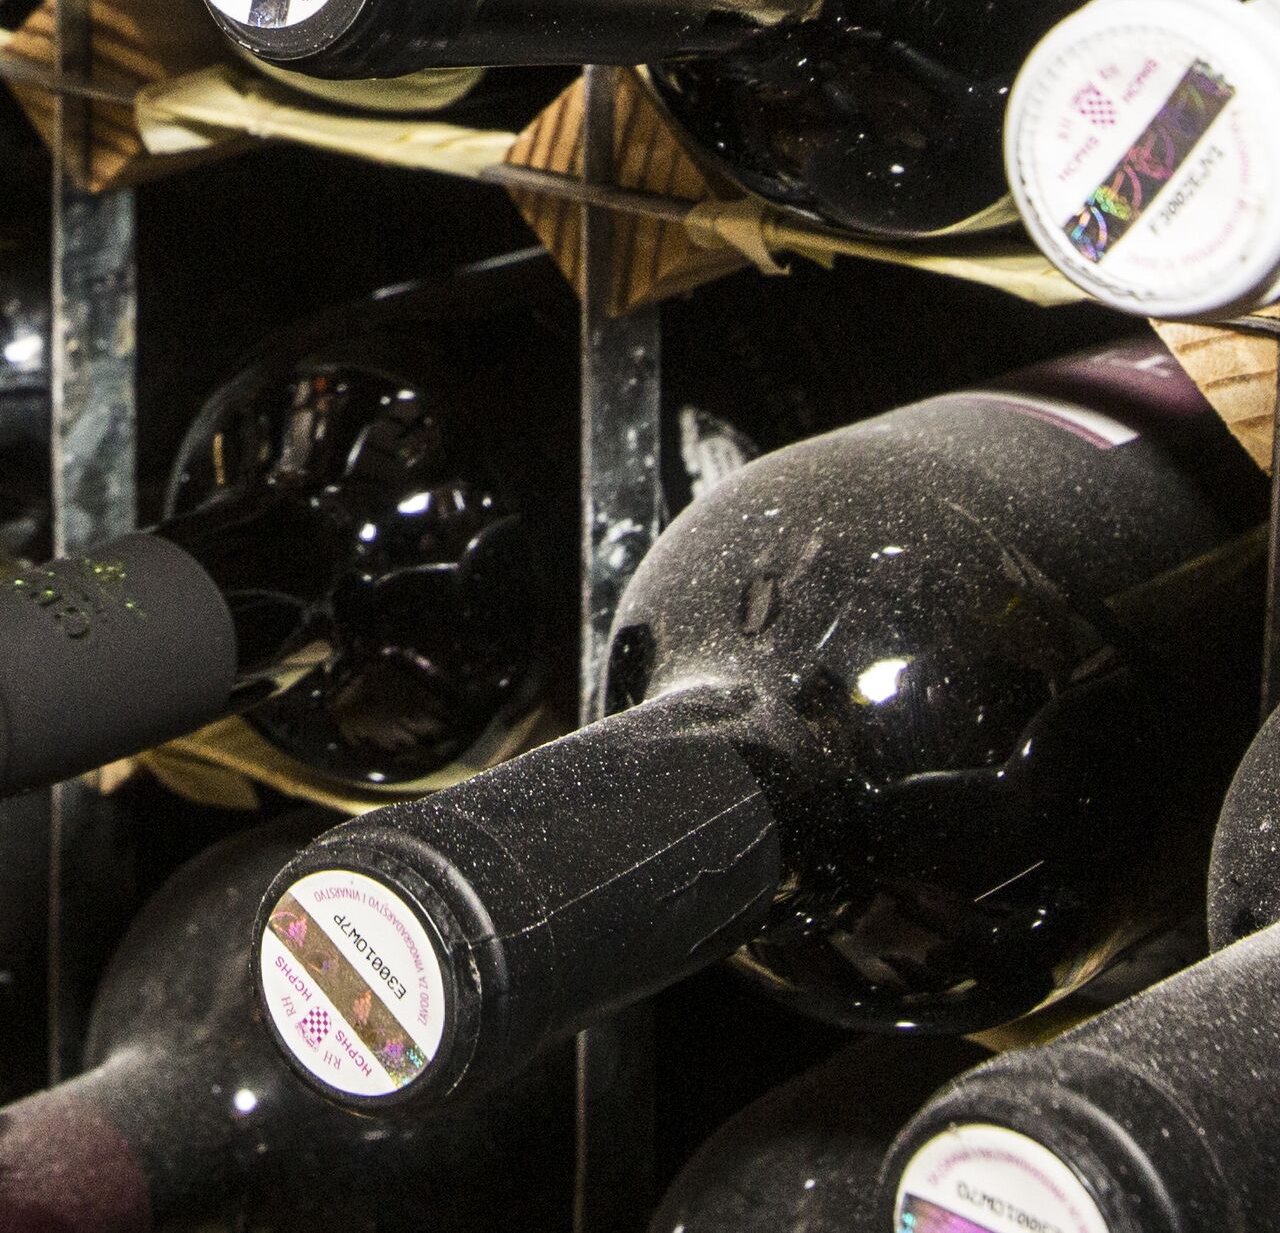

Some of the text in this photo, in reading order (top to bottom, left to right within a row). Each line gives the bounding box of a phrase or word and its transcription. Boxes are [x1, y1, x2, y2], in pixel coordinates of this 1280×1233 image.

[314, 887, 361, 903] VINARSTVO
[274, 955, 313, 1002] HCPHS
[417, 991, 430, 1027] ZAVOD
[335, 1029, 373, 1077] HCPHS
